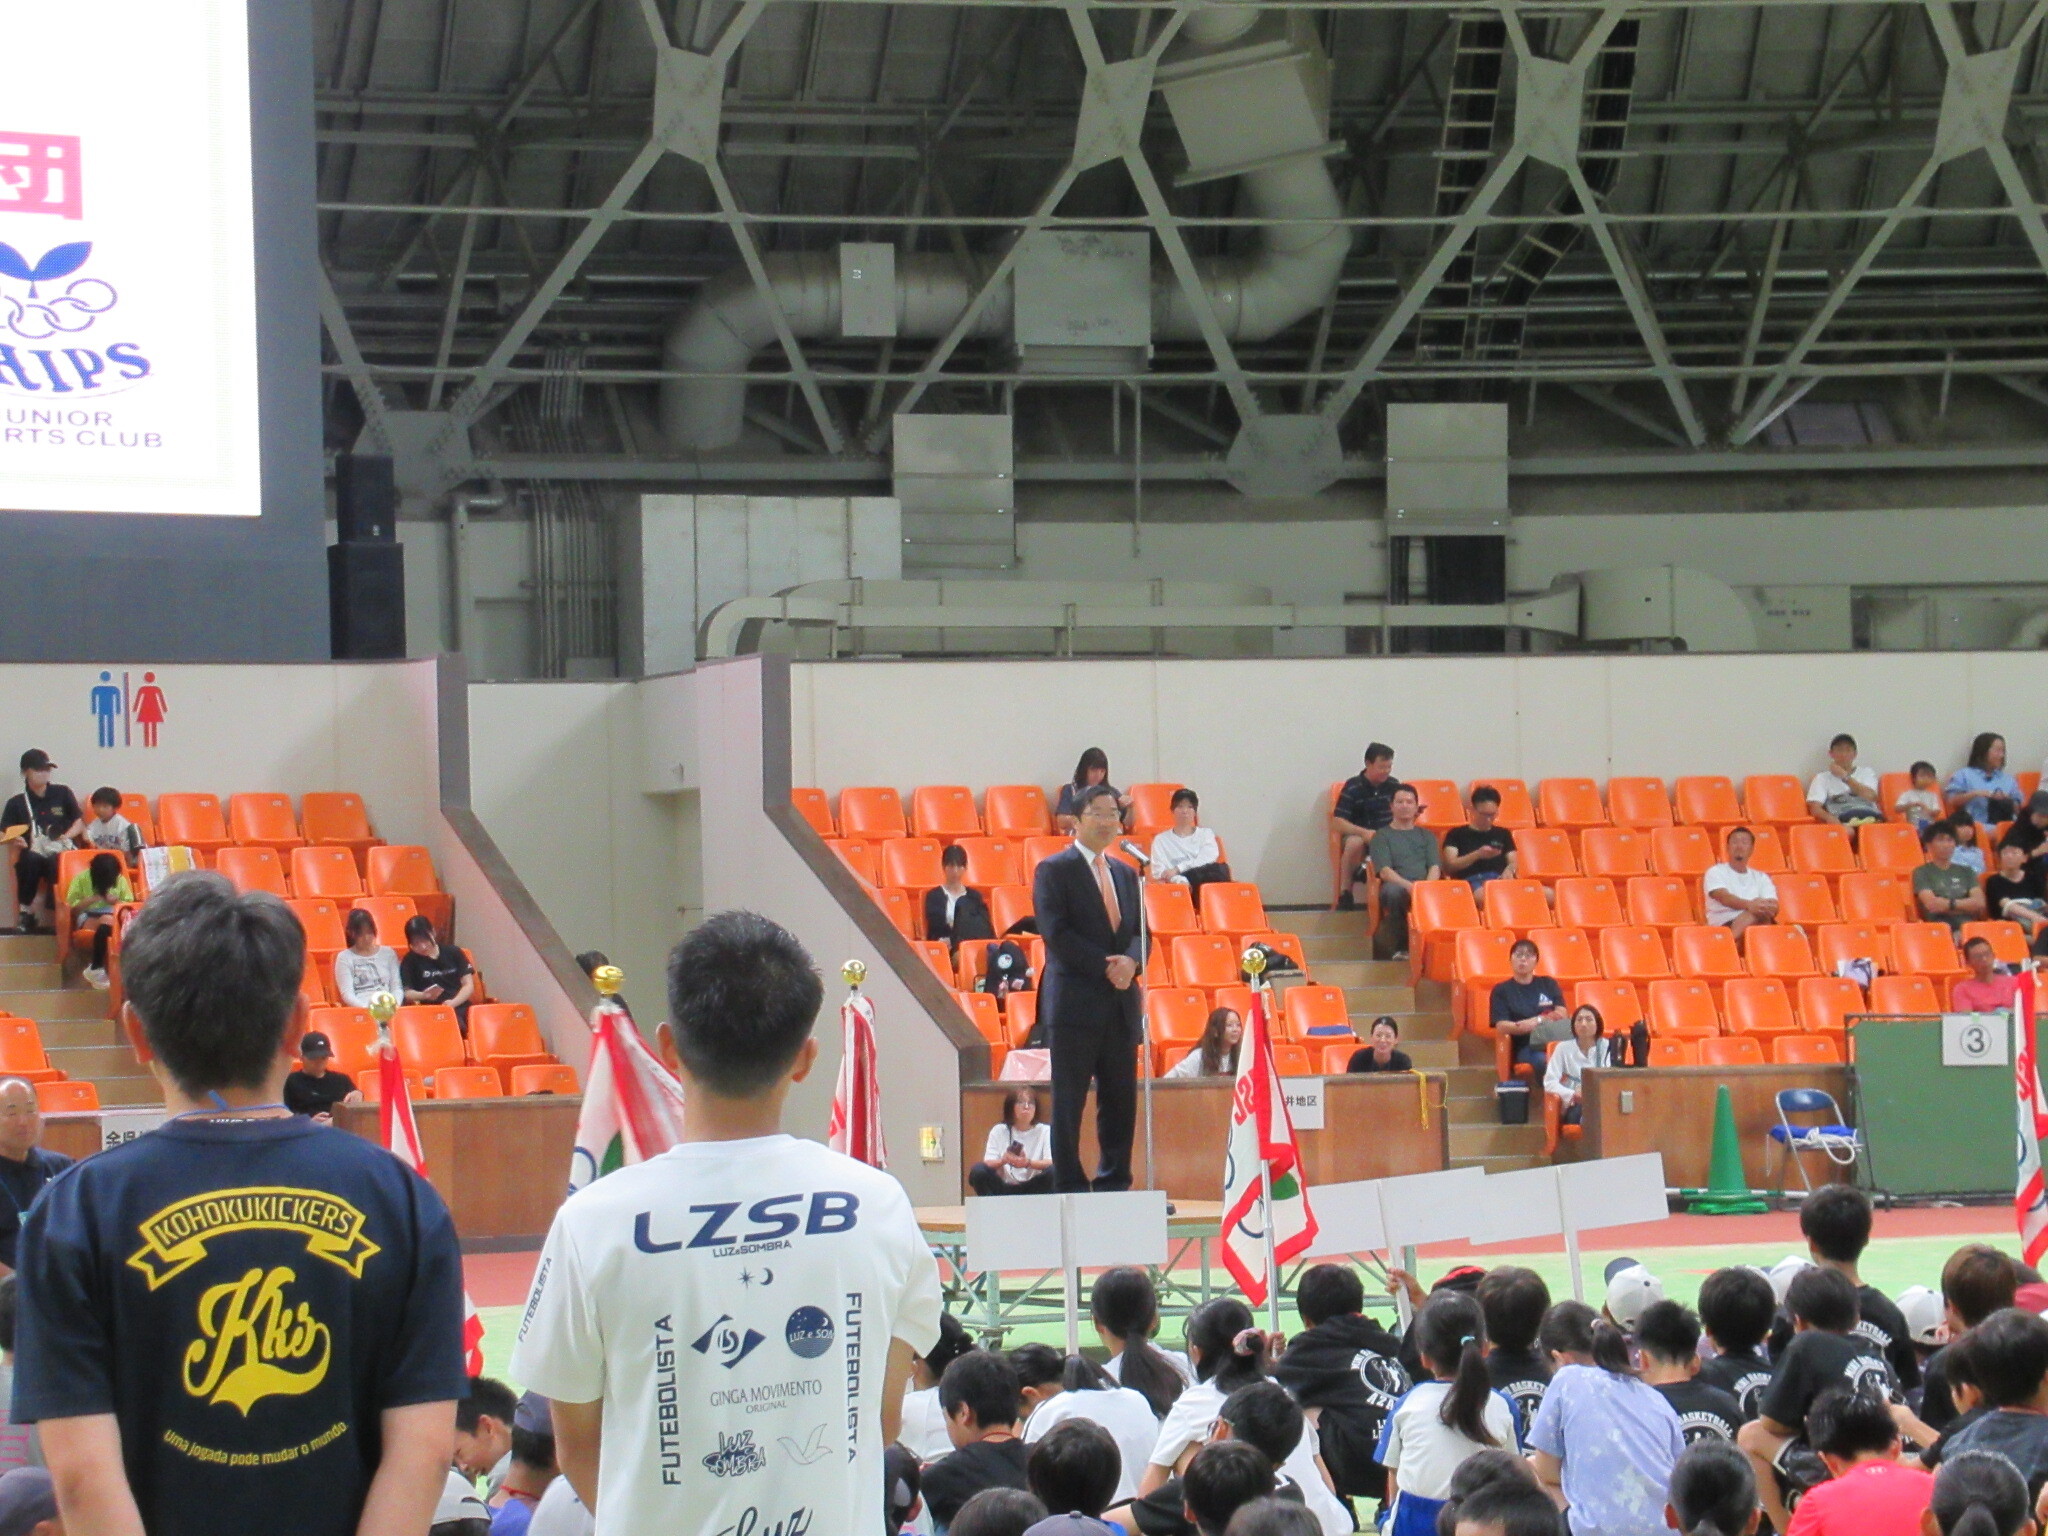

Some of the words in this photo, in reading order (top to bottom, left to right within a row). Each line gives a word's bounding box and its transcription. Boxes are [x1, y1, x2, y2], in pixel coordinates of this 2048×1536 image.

[0, 130, 83, 220] 団
[5, 428, 65, 445] RTS
[76, 430, 162, 447] CLUB
[6, 408, 112, 427] UNIOR
[153, 1196, 354, 1246] KOHOKUKICKERS
[633, 1190, 860, 1254] LZSB
[518, 1257, 552, 1342] FUTEBOLISTA
[655, 1314, 681, 1485] FUTEBOLISTA
[710, 1388, 747, 1407] GINGA
[751, 1380, 822, 1401] MOVIMENTO
[845, 1293, 862, 1463] FUTEBOLISTA
[746, 1401, 787, 1414] ORIGINAL
[187, 1442, 229, 1464] jogada
[228, 1452, 260, 1467] pode
[261, 1446, 299, 1464] mudar
[300, 1443, 310, 1456] o
